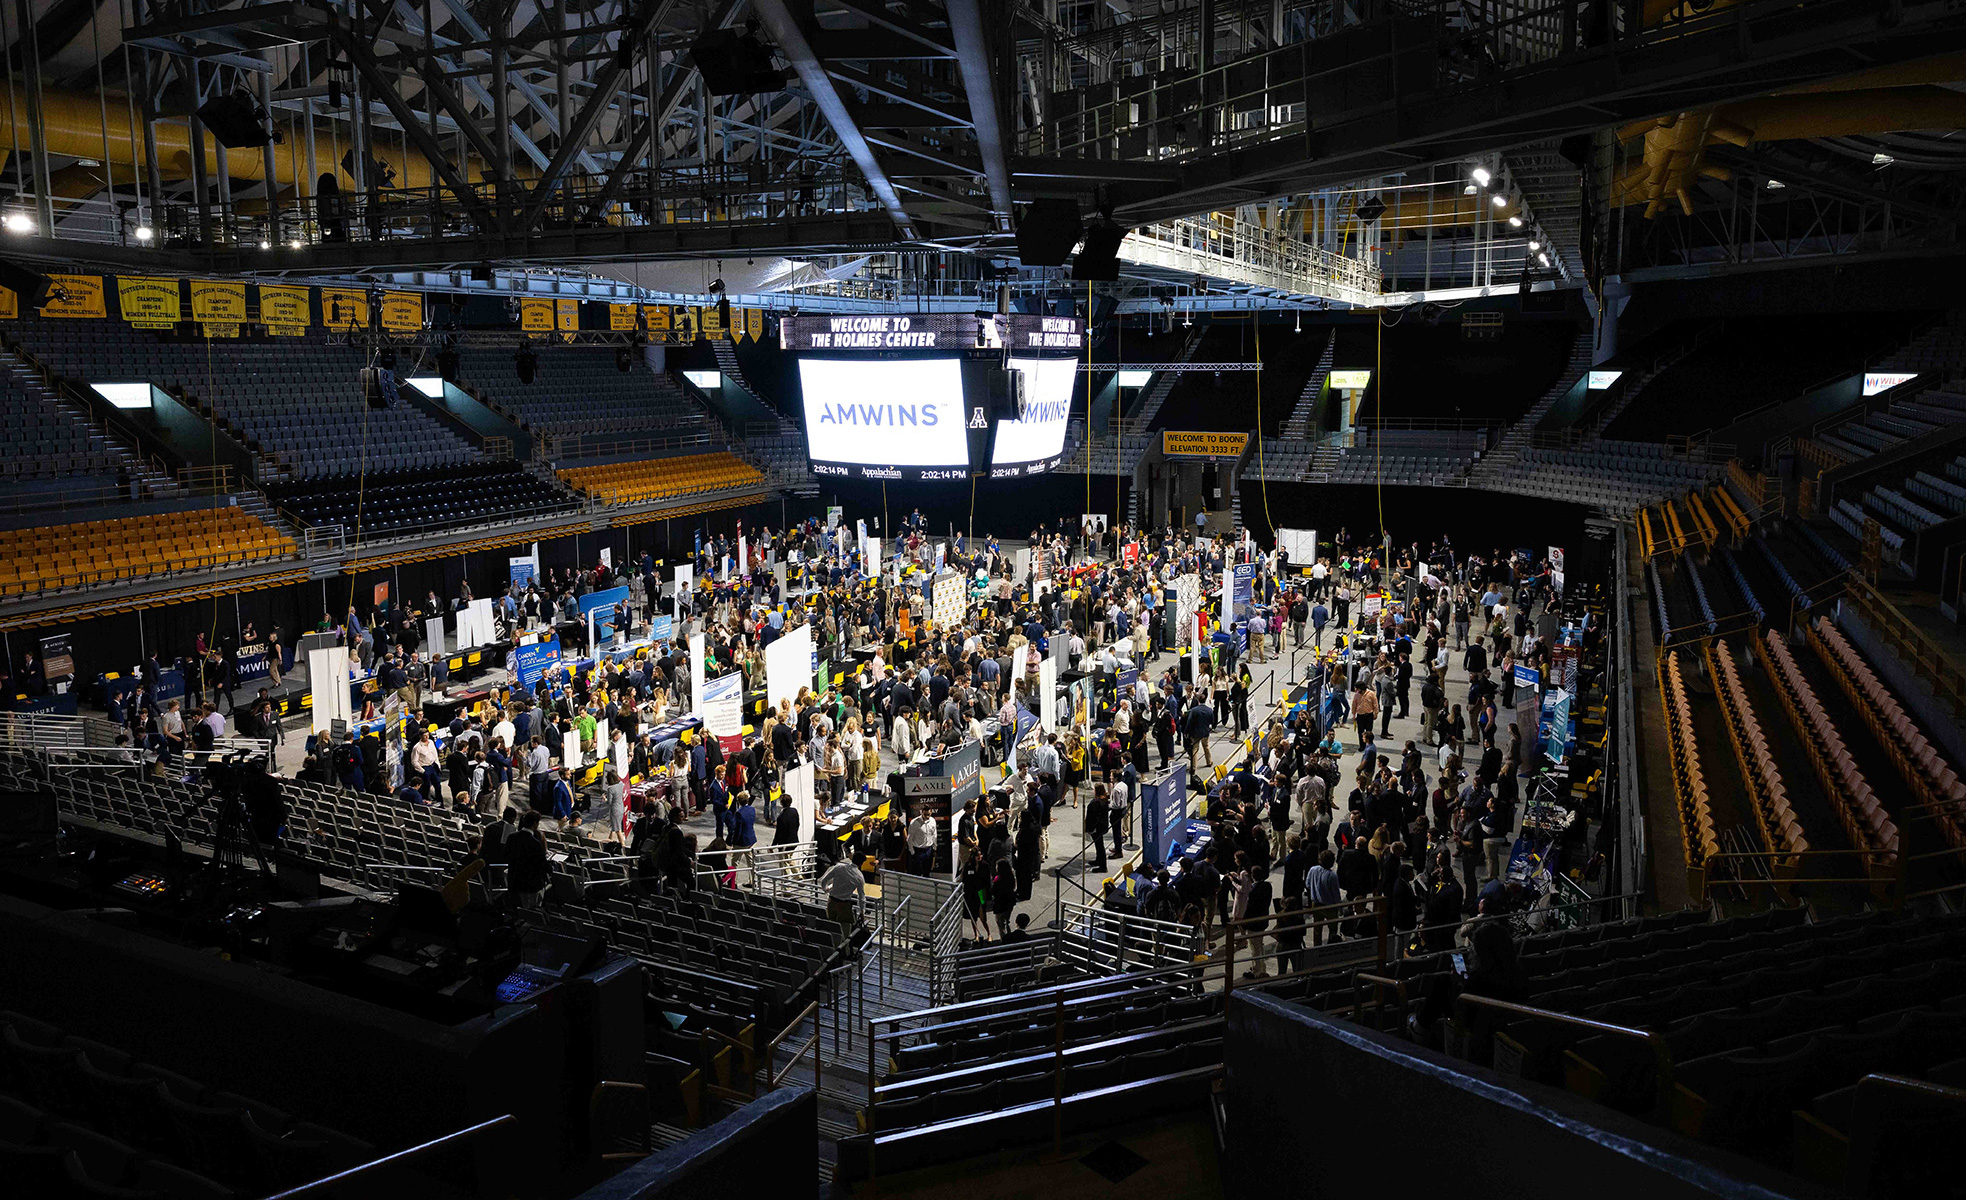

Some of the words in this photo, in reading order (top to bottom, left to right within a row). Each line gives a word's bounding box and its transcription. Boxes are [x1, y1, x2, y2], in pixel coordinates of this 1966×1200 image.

[120, 285, 146, 296] SOUTHERN
[147, 284, 178, 297] CONFERENCE
[216, 287, 245, 299] CONFERENCE
[734, 320, 741, 329] 33
[751, 320, 759, 328] 22
[830, 317, 889, 333] WELCOME
[892, 317, 911, 332] TO
[1042, 318, 1070, 333] WELCOME
[811, 333, 832, 347] THE
[834, 332, 883, 348] HOLMES
[886, 332, 936, 348] CENTER
[1028, 332, 1043, 347] THE
[1043, 332, 1068, 347] HOLMES
[820, 402, 939, 426] AMWINS
[970, 407, 987, 429] A
[1167, 434, 1204, 443] WELCOME
[1206, 435, 1217, 443] TO
[1219, 435, 1245, 443] BOONE
[1170, 444, 1208, 453] ELEVATION
[1230, 446, 1241, 454] FT.
[813, 465, 836, 475] 2:02:14
[837, 467, 849, 476] PM
[861, 467, 902, 478] Appalachian
[921, 471, 951, 479] 2:02:14
[952, 470, 966, 479] PM
[957, 758, 979, 784] AXLE
[922, 782, 946, 790] AXLE
